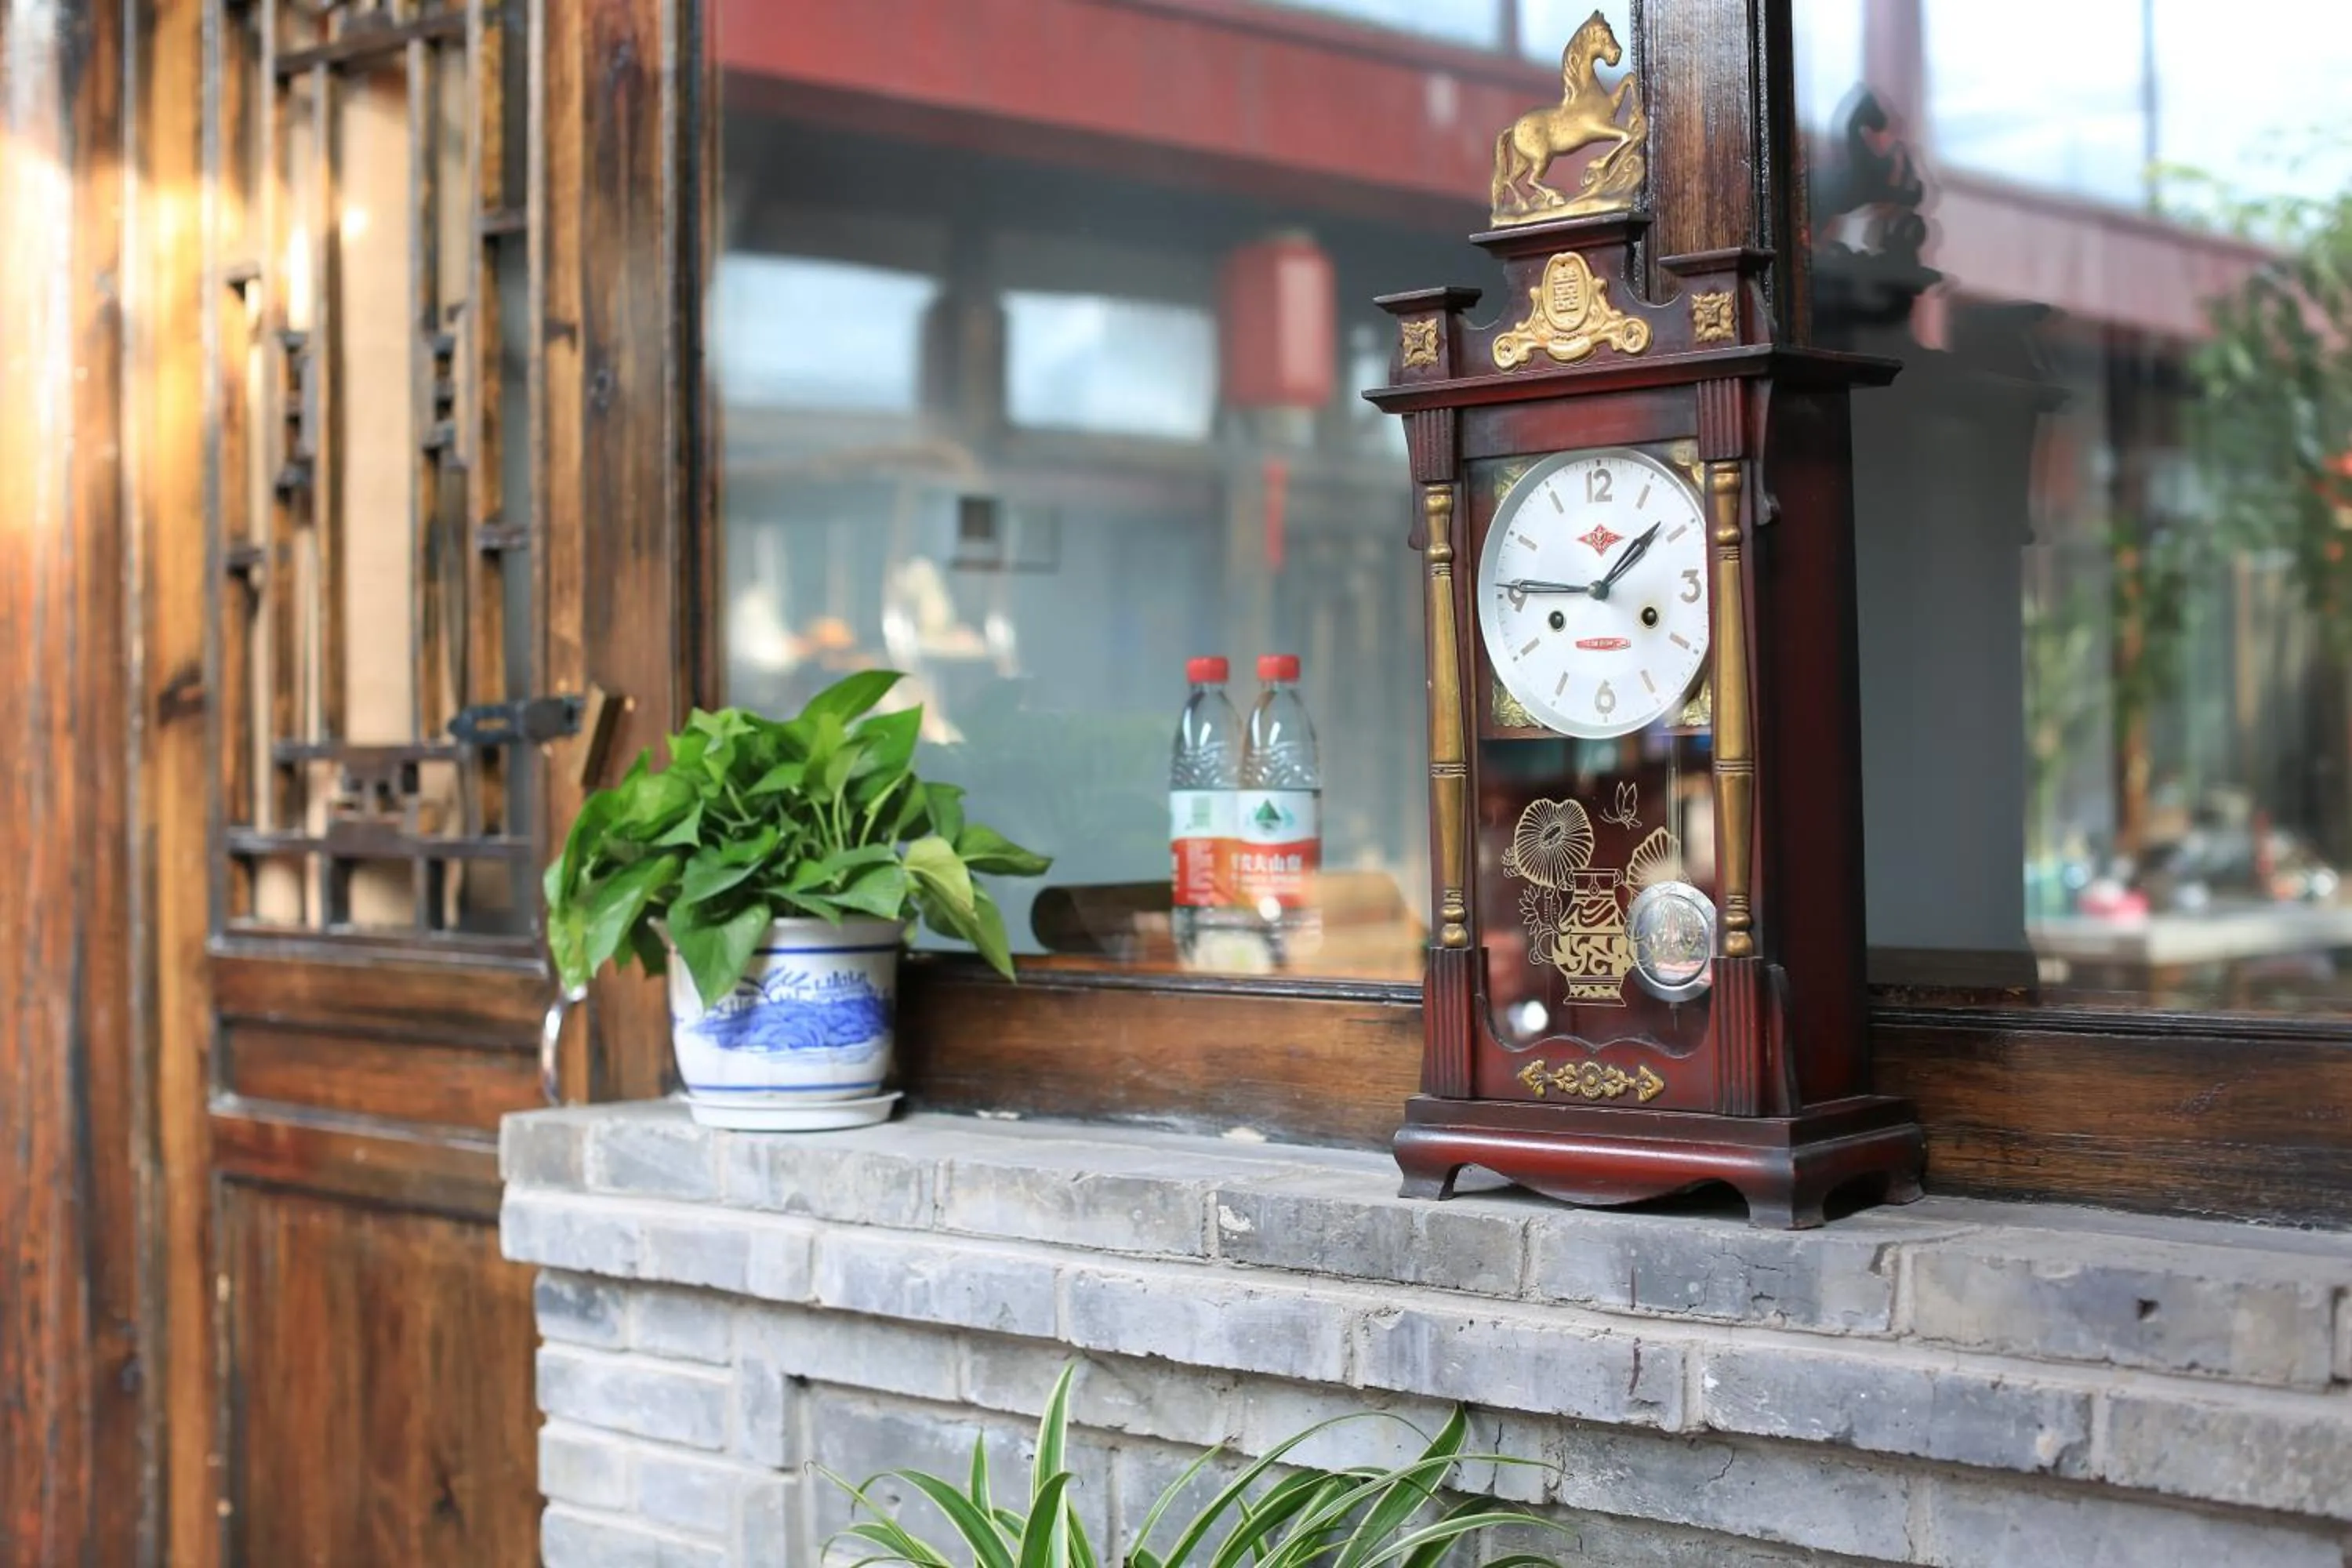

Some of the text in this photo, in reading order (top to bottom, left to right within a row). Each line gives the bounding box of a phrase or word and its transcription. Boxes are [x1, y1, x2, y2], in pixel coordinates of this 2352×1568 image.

[1585, 468, 1613, 503] 12
[1508, 579, 1527, 612] 9
[1680, 569, 1701, 603] 3
[1594, 679, 1616, 713] 6
